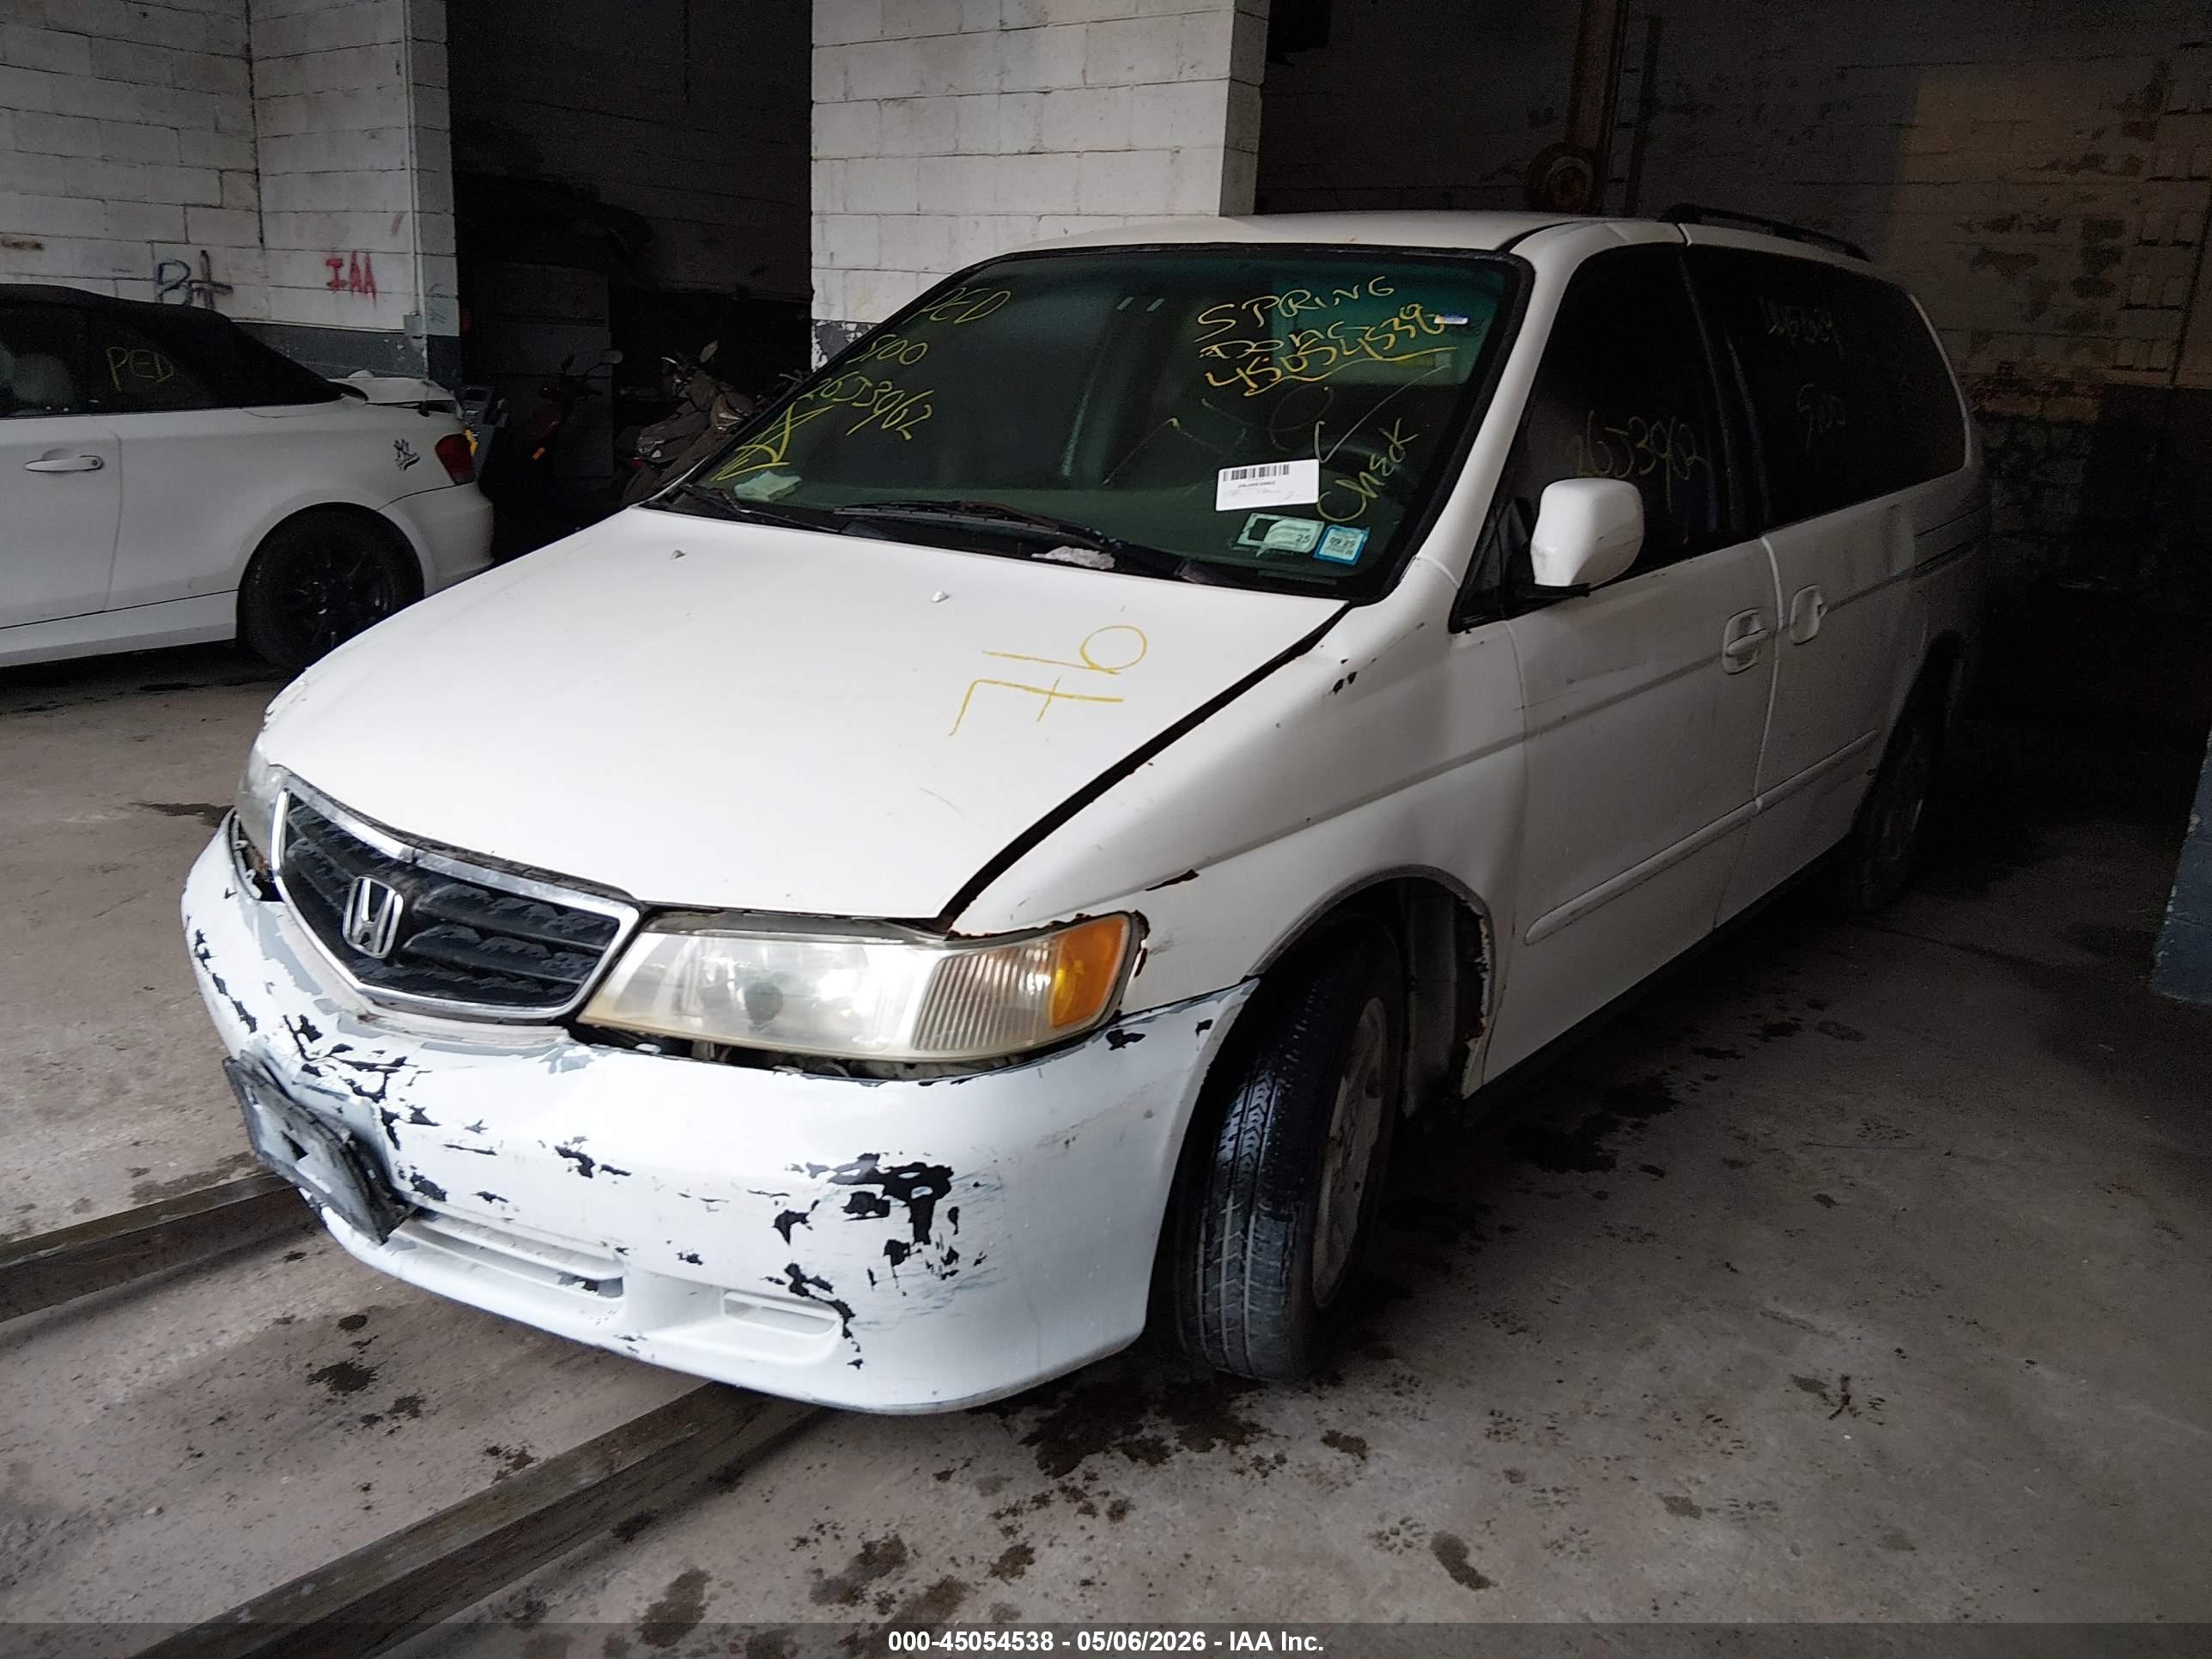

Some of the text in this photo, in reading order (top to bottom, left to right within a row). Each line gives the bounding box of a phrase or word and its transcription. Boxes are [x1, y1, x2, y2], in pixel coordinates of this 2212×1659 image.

[325, 250, 377, 307] IAA
[901, 286, 1012, 325] PED
[1194, 276, 1395, 343] SPRING
[103, 345, 176, 392] PED
